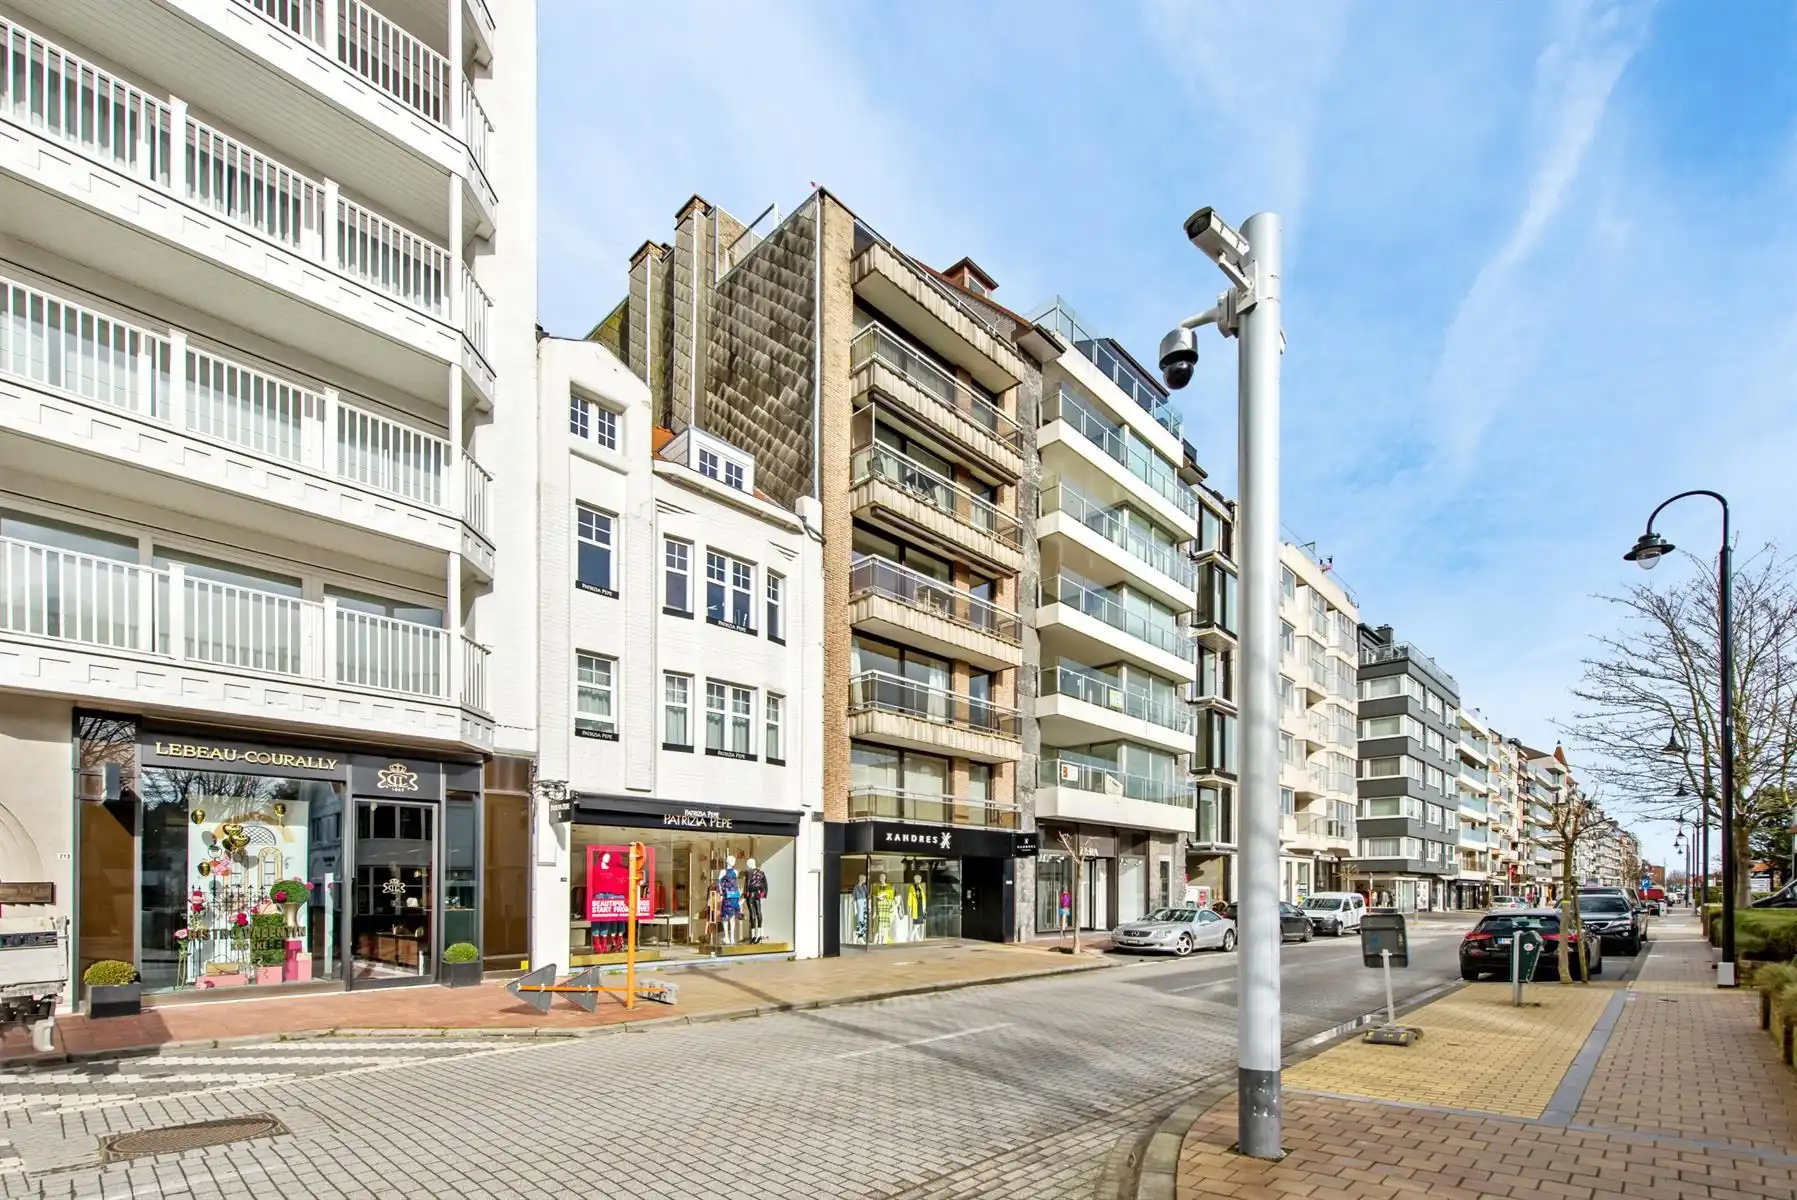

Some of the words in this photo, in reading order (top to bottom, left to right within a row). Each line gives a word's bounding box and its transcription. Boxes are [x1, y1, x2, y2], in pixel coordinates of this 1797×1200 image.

[154, 741, 338, 771] LEBEAU-COURALLY
[684, 809, 706, 818] PATRIZIA
[663, 814, 707, 828] PATRIZIA
[710, 817, 733, 829] PEPE
[885, 832, 938, 844] XANDRES
